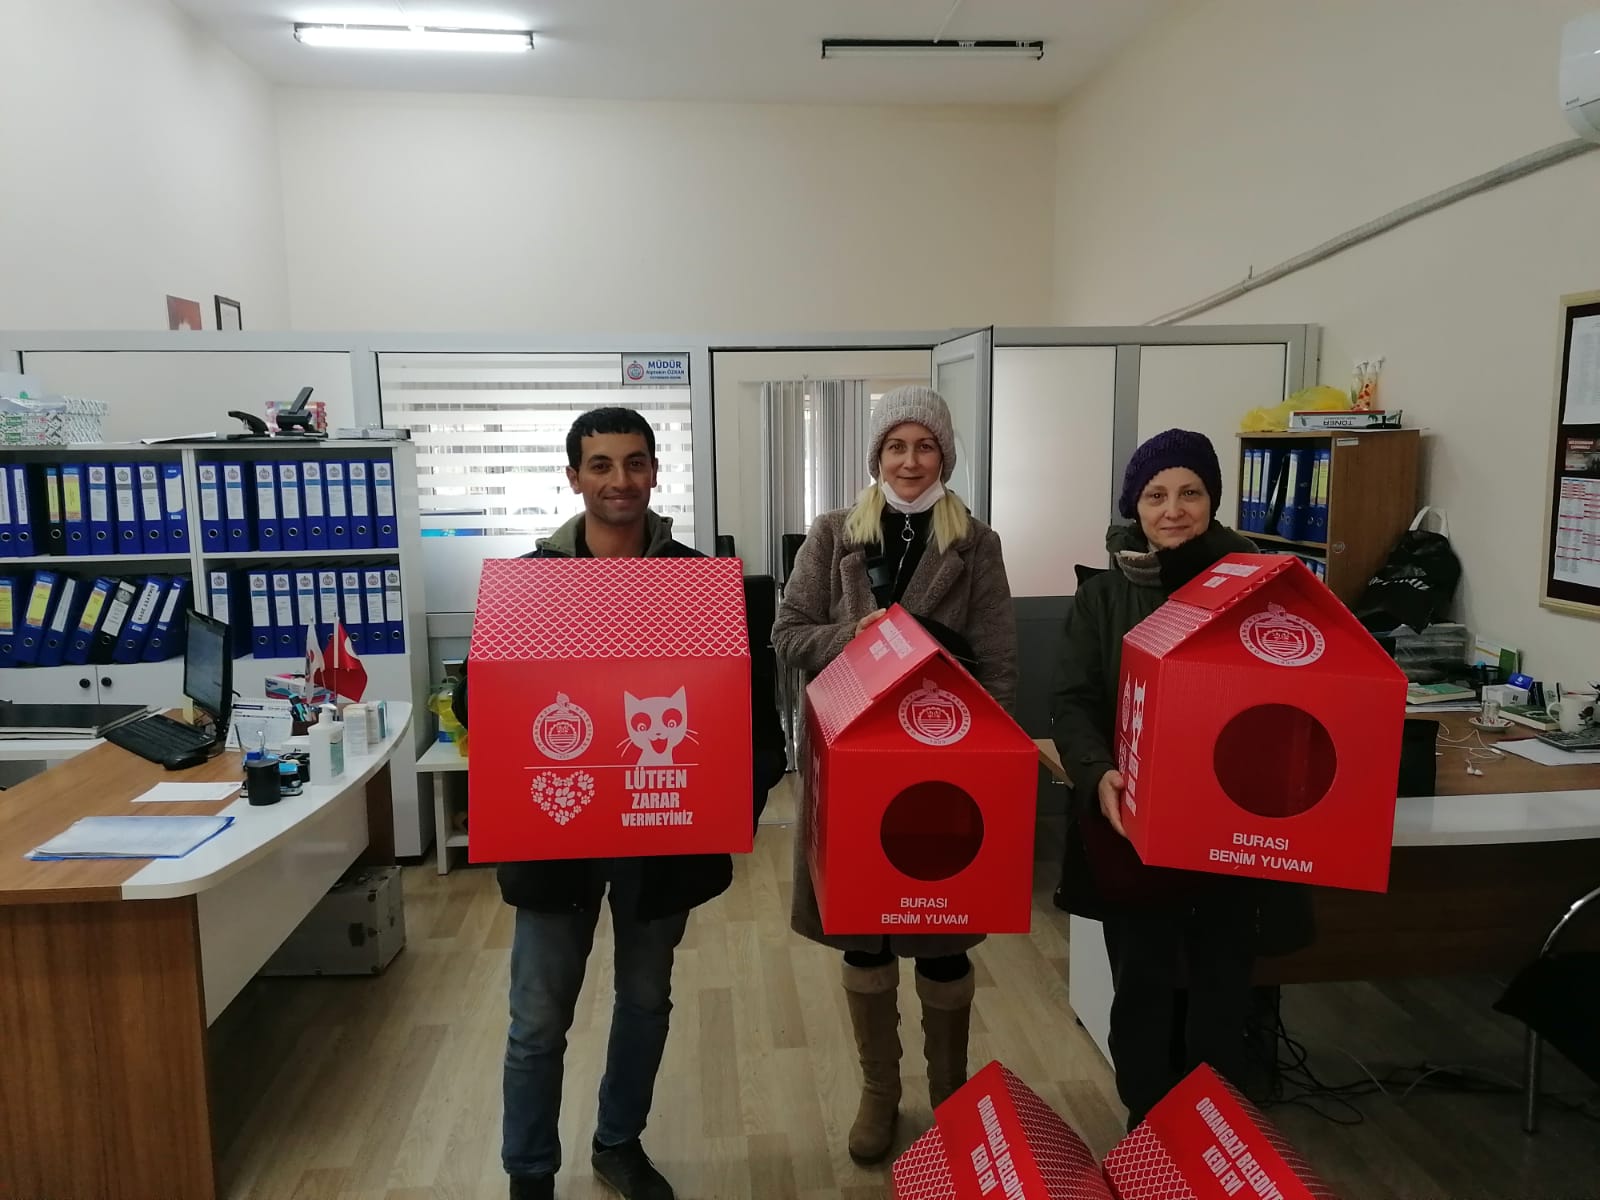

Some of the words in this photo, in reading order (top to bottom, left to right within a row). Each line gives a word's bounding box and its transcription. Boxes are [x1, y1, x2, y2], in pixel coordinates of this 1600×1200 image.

[648, 360, 682, 368] MÜDÜR
[625, 766, 687, 790] LÜTFEN
[631, 791, 680, 809] ZARAR
[621, 809, 693, 827] VERMEYİNİZ
[1233, 832, 1289, 851] BURASI
[1209, 848, 1256, 866] BENİM
[1261, 855, 1313, 873] YUVAM
[900, 897, 948, 909] BURASI
[881, 911, 921, 924] BENİM
[925, 914, 969, 925] YUVAM
[1195, 1097, 1249, 1160] ORHANGAZİ
[970, 1143, 993, 1177] KEDİ
[1201, 1144, 1232, 1178] KEDİ
[1219, 1169, 1246, 1197] EVİ
[978, 1169, 999, 1197] EVİ
